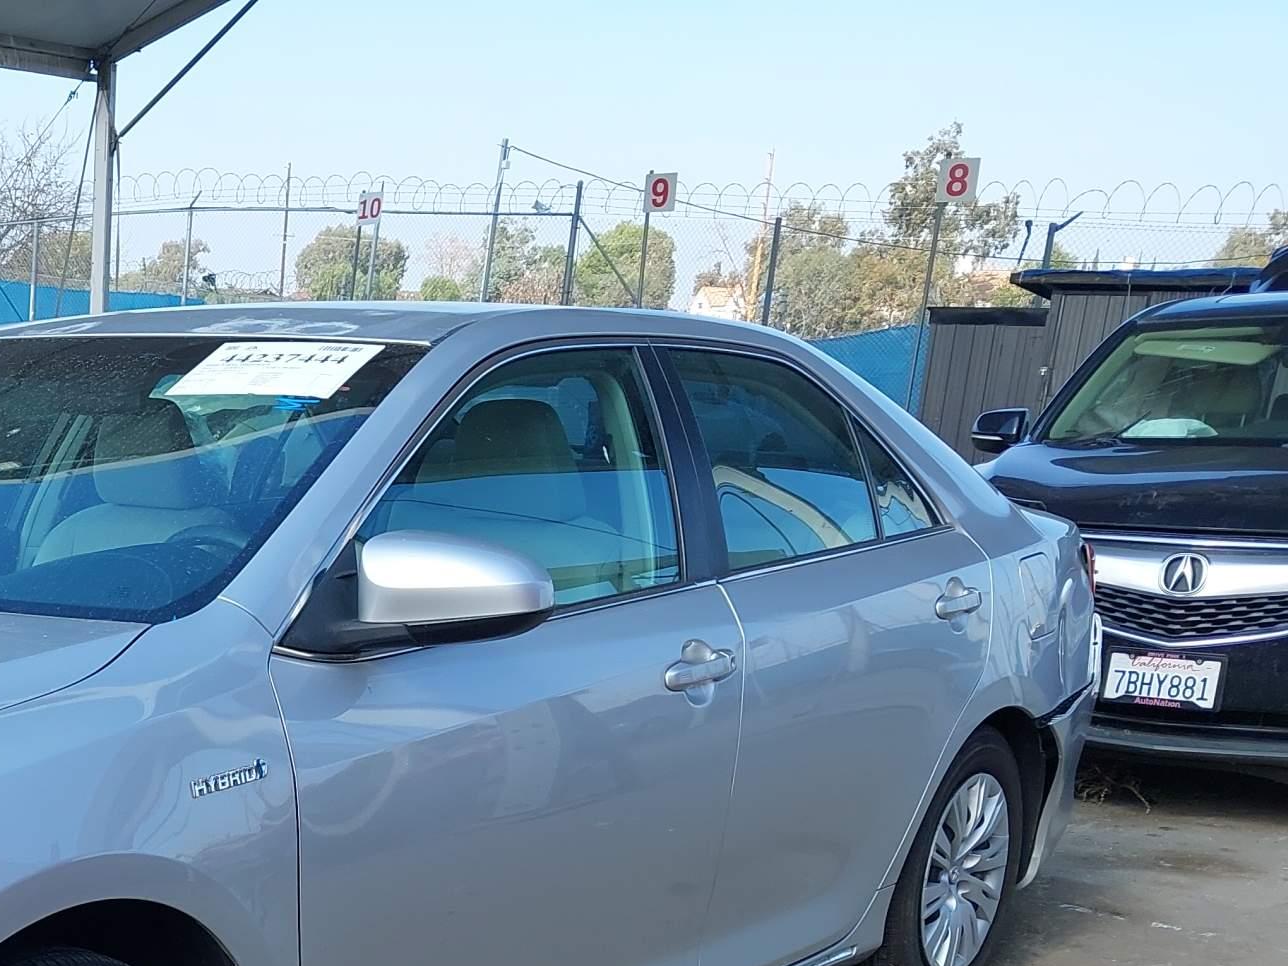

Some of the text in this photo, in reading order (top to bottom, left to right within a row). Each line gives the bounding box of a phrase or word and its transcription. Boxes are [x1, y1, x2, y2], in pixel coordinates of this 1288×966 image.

[946, 163, 969, 196] 8
[651, 178, 669, 208] 9
[358, 197, 381, 220] 10
[220, 352, 350, 365] 44237444
[1131, 656, 1200, 672] California
[1114, 670, 1209, 701] 7BHY881
[1133, 696, 1181, 709] AutoNation
[190, 766, 257, 799] HYBRID
